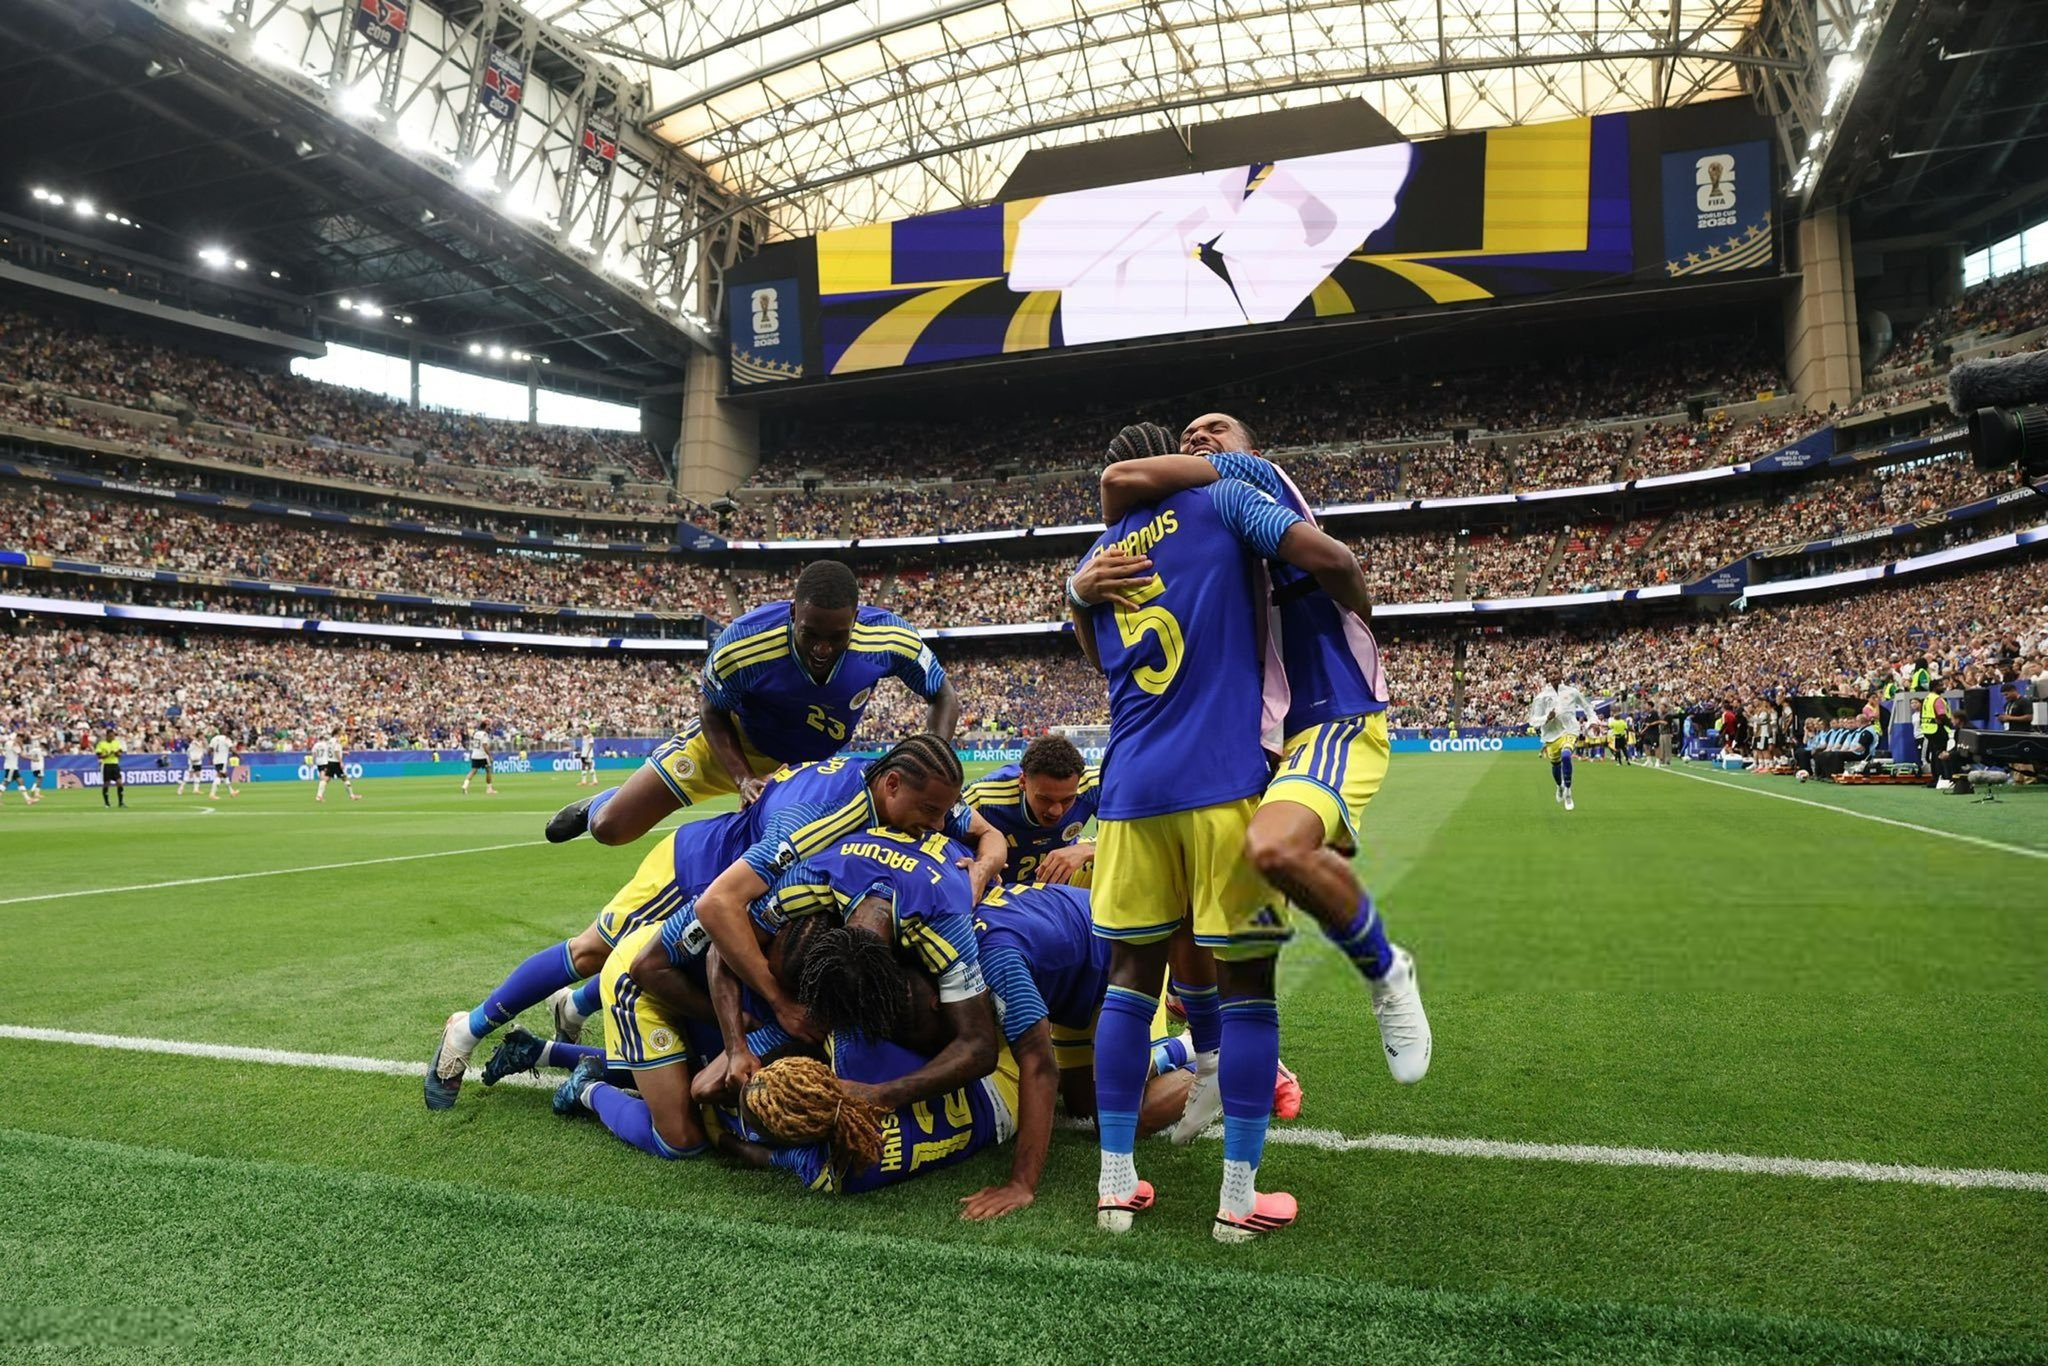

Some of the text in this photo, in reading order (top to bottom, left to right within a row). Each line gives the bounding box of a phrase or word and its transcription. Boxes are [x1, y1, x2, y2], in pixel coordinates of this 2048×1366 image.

[366, 21, 391, 45] 2019
[489, 96, 509, 116] 2023
[585, 154, 605, 174] 2024
[1708, 198, 1727, 206] FIFA
[1697, 215, 1738, 229] 2026
[425, 526, 462, 536] HOUSTON
[101, 566, 156, 579] HOUSTON
[432, 597, 471, 607] HOUSTON
[1114, 572, 1185, 695] 5
[806, 705, 846, 740] 23
[1430, 737, 1503, 752] aramco
[973, 749, 1022, 761] PARTNER
[298, 763, 363, 780] arco
[493, 760, 530, 772] PARTNER
[127, 770, 167, 783] STATES
[168, 769, 182, 782] OF
[840, 843, 920, 873] BACUNA
